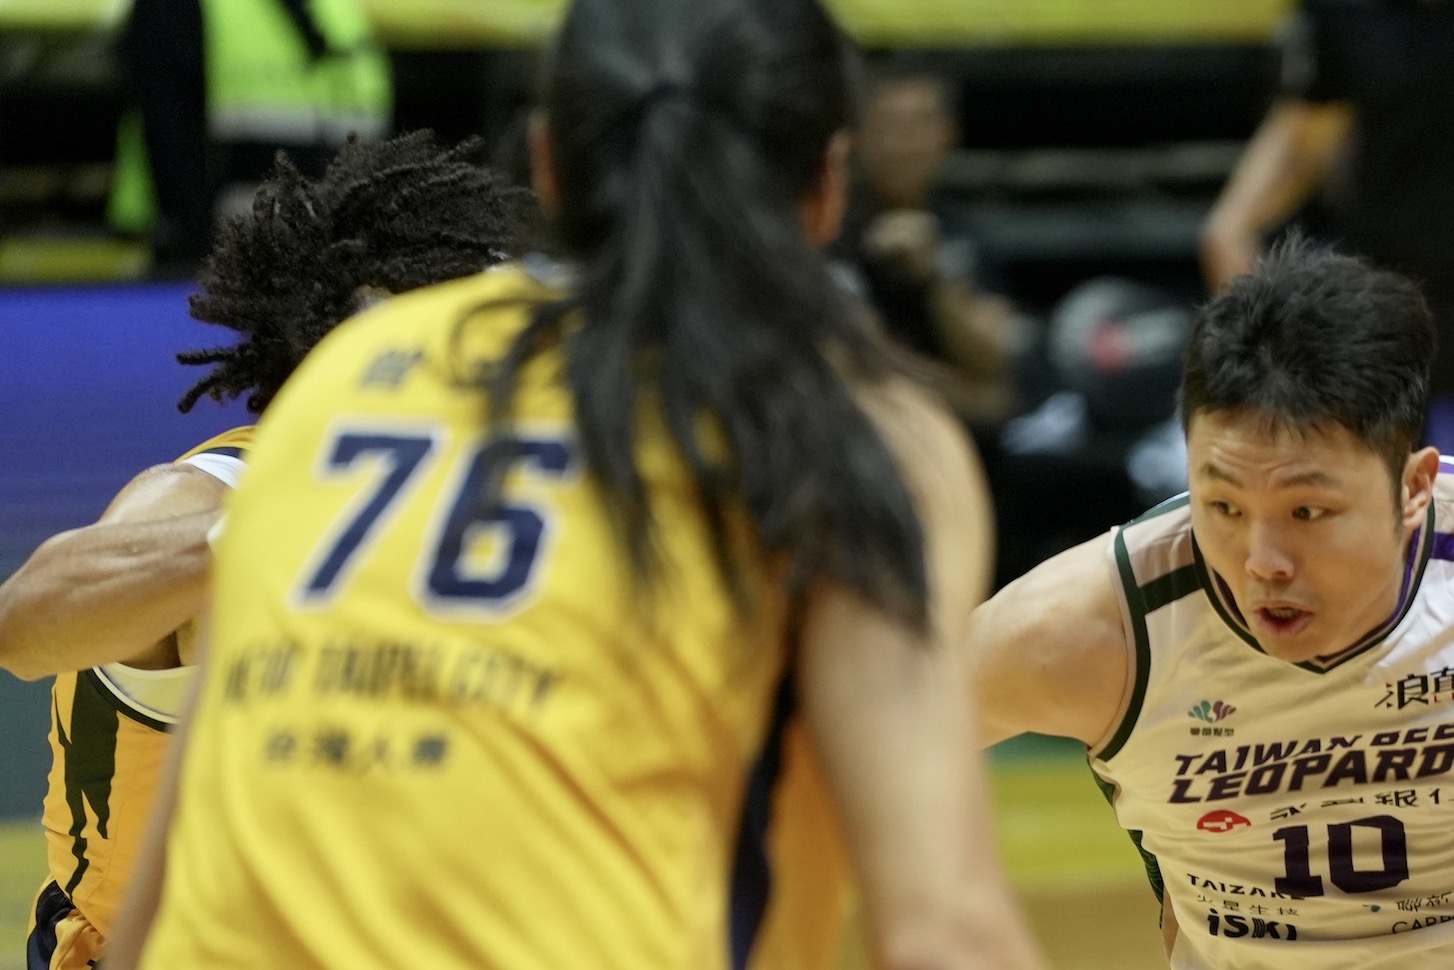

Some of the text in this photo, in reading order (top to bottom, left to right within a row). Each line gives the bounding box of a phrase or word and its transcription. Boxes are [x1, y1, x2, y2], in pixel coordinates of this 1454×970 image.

[290, 416, 582, 620] 76
[1174, 735, 1363, 776] TAIWAN
[1272, 814, 1410, 898] 10
